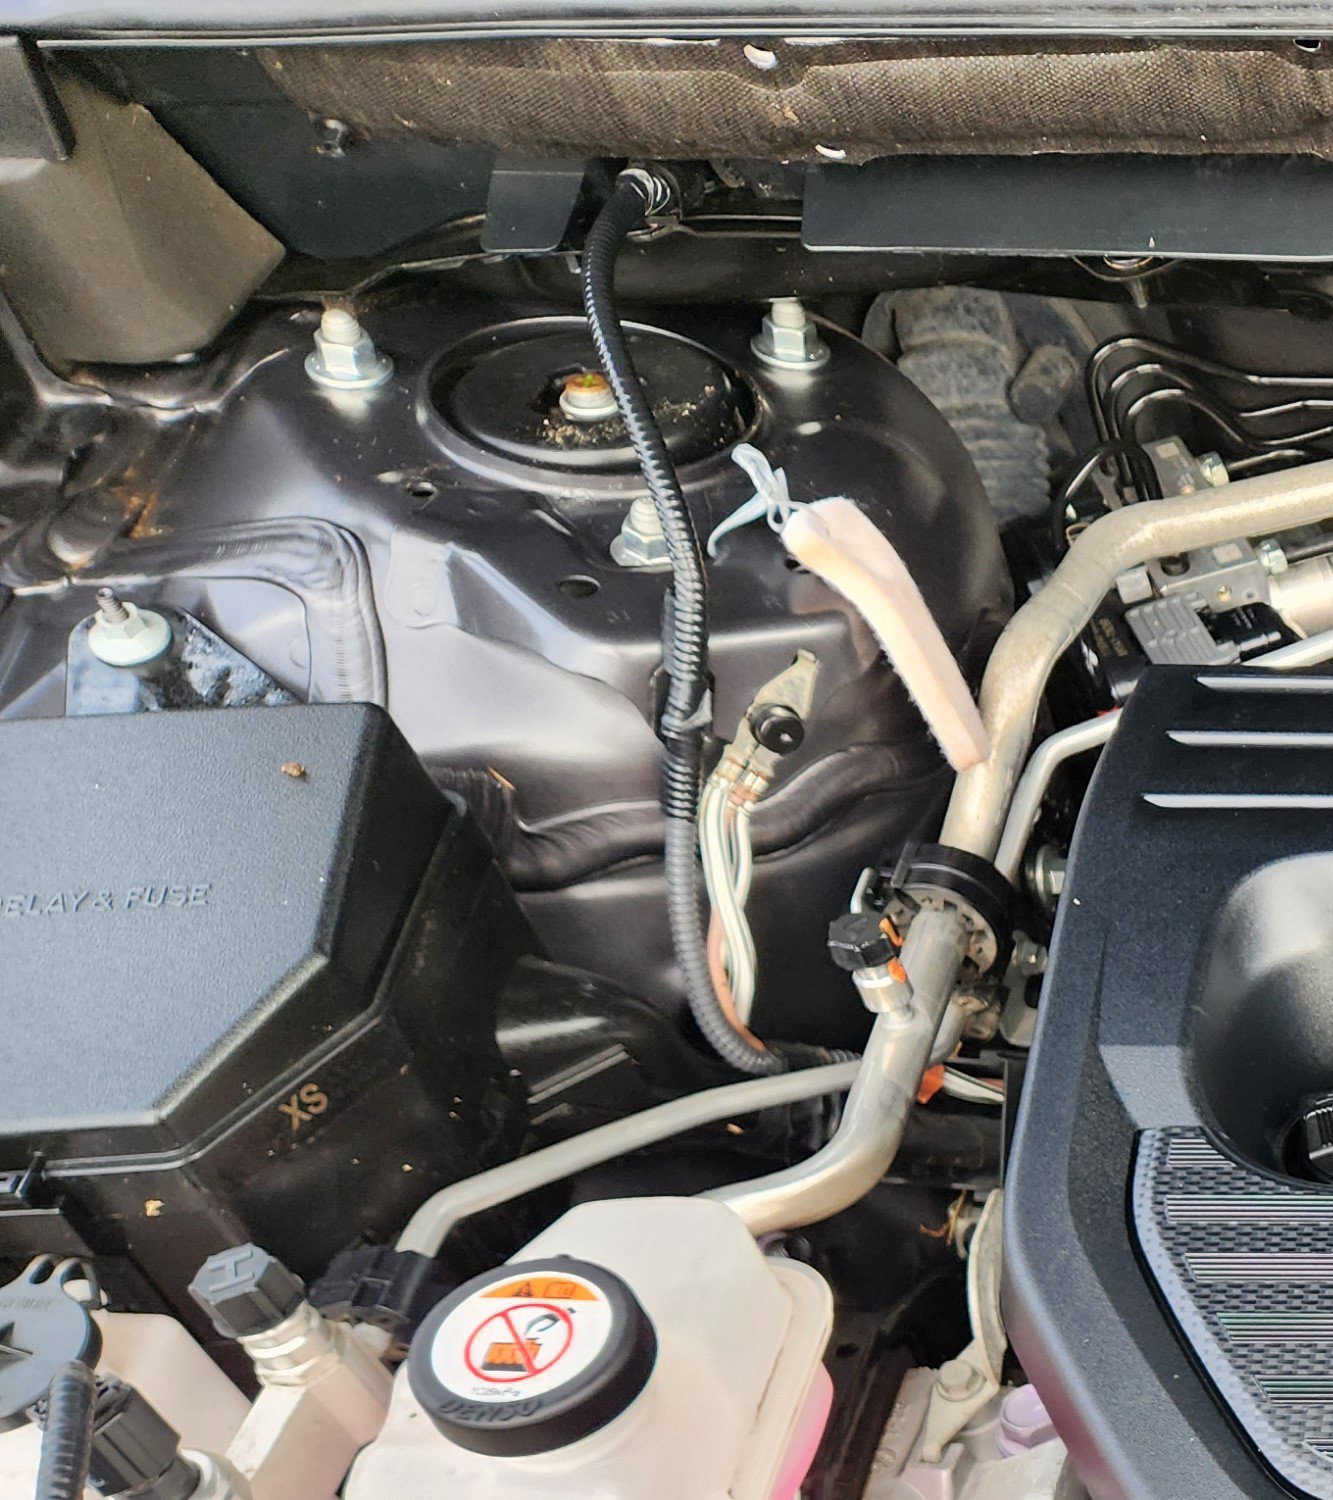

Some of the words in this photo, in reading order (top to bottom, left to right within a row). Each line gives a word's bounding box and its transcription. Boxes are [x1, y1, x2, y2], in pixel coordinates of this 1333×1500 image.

[0, 890, 90, 917] ELAY
[93, 889, 114, 911] &
[124, 882, 212, 910] FUSE
[278, 1083, 328, 1130] XS
[440, 1401, 543, 1422] DENSO
